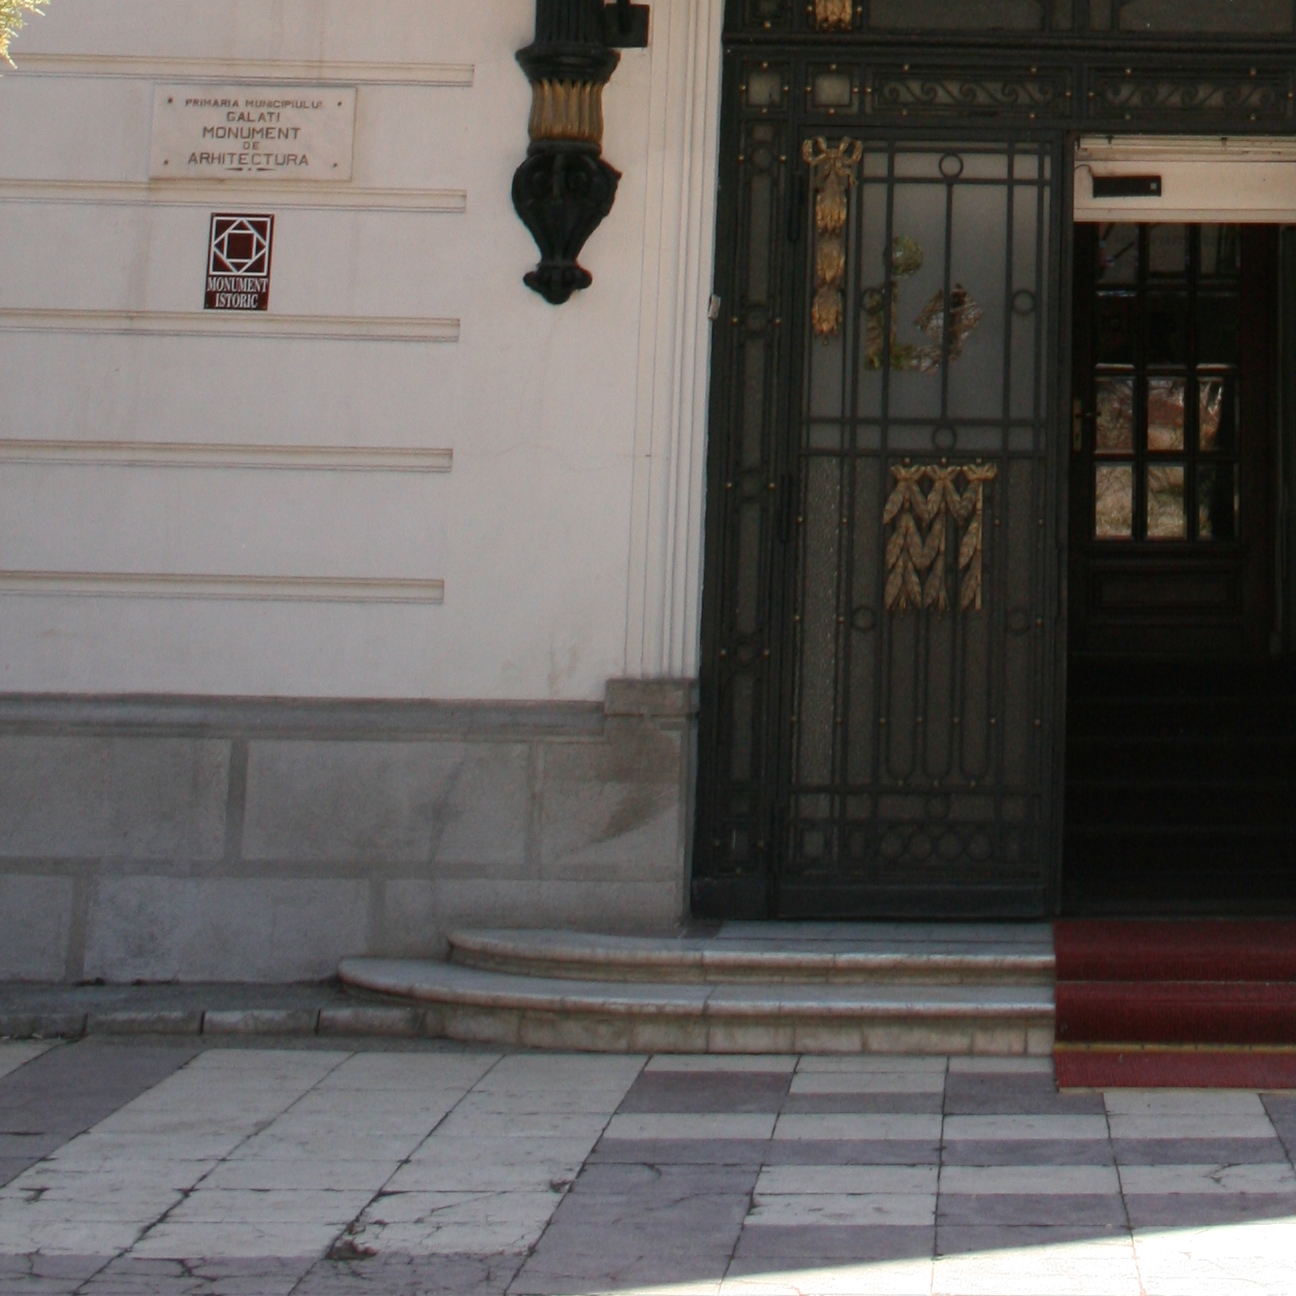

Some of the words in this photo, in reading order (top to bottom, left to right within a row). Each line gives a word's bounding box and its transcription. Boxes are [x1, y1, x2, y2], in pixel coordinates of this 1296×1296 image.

[185, 98, 239, 108] PRIMARIA
[202, 126, 301, 140] MONUMENT
[242, 141, 260, 151] DE
[188, 152, 309, 167] ARHITECTURA
[206, 276, 269, 293] MONUMENT
[215, 293, 259, 308] ISTORIC
